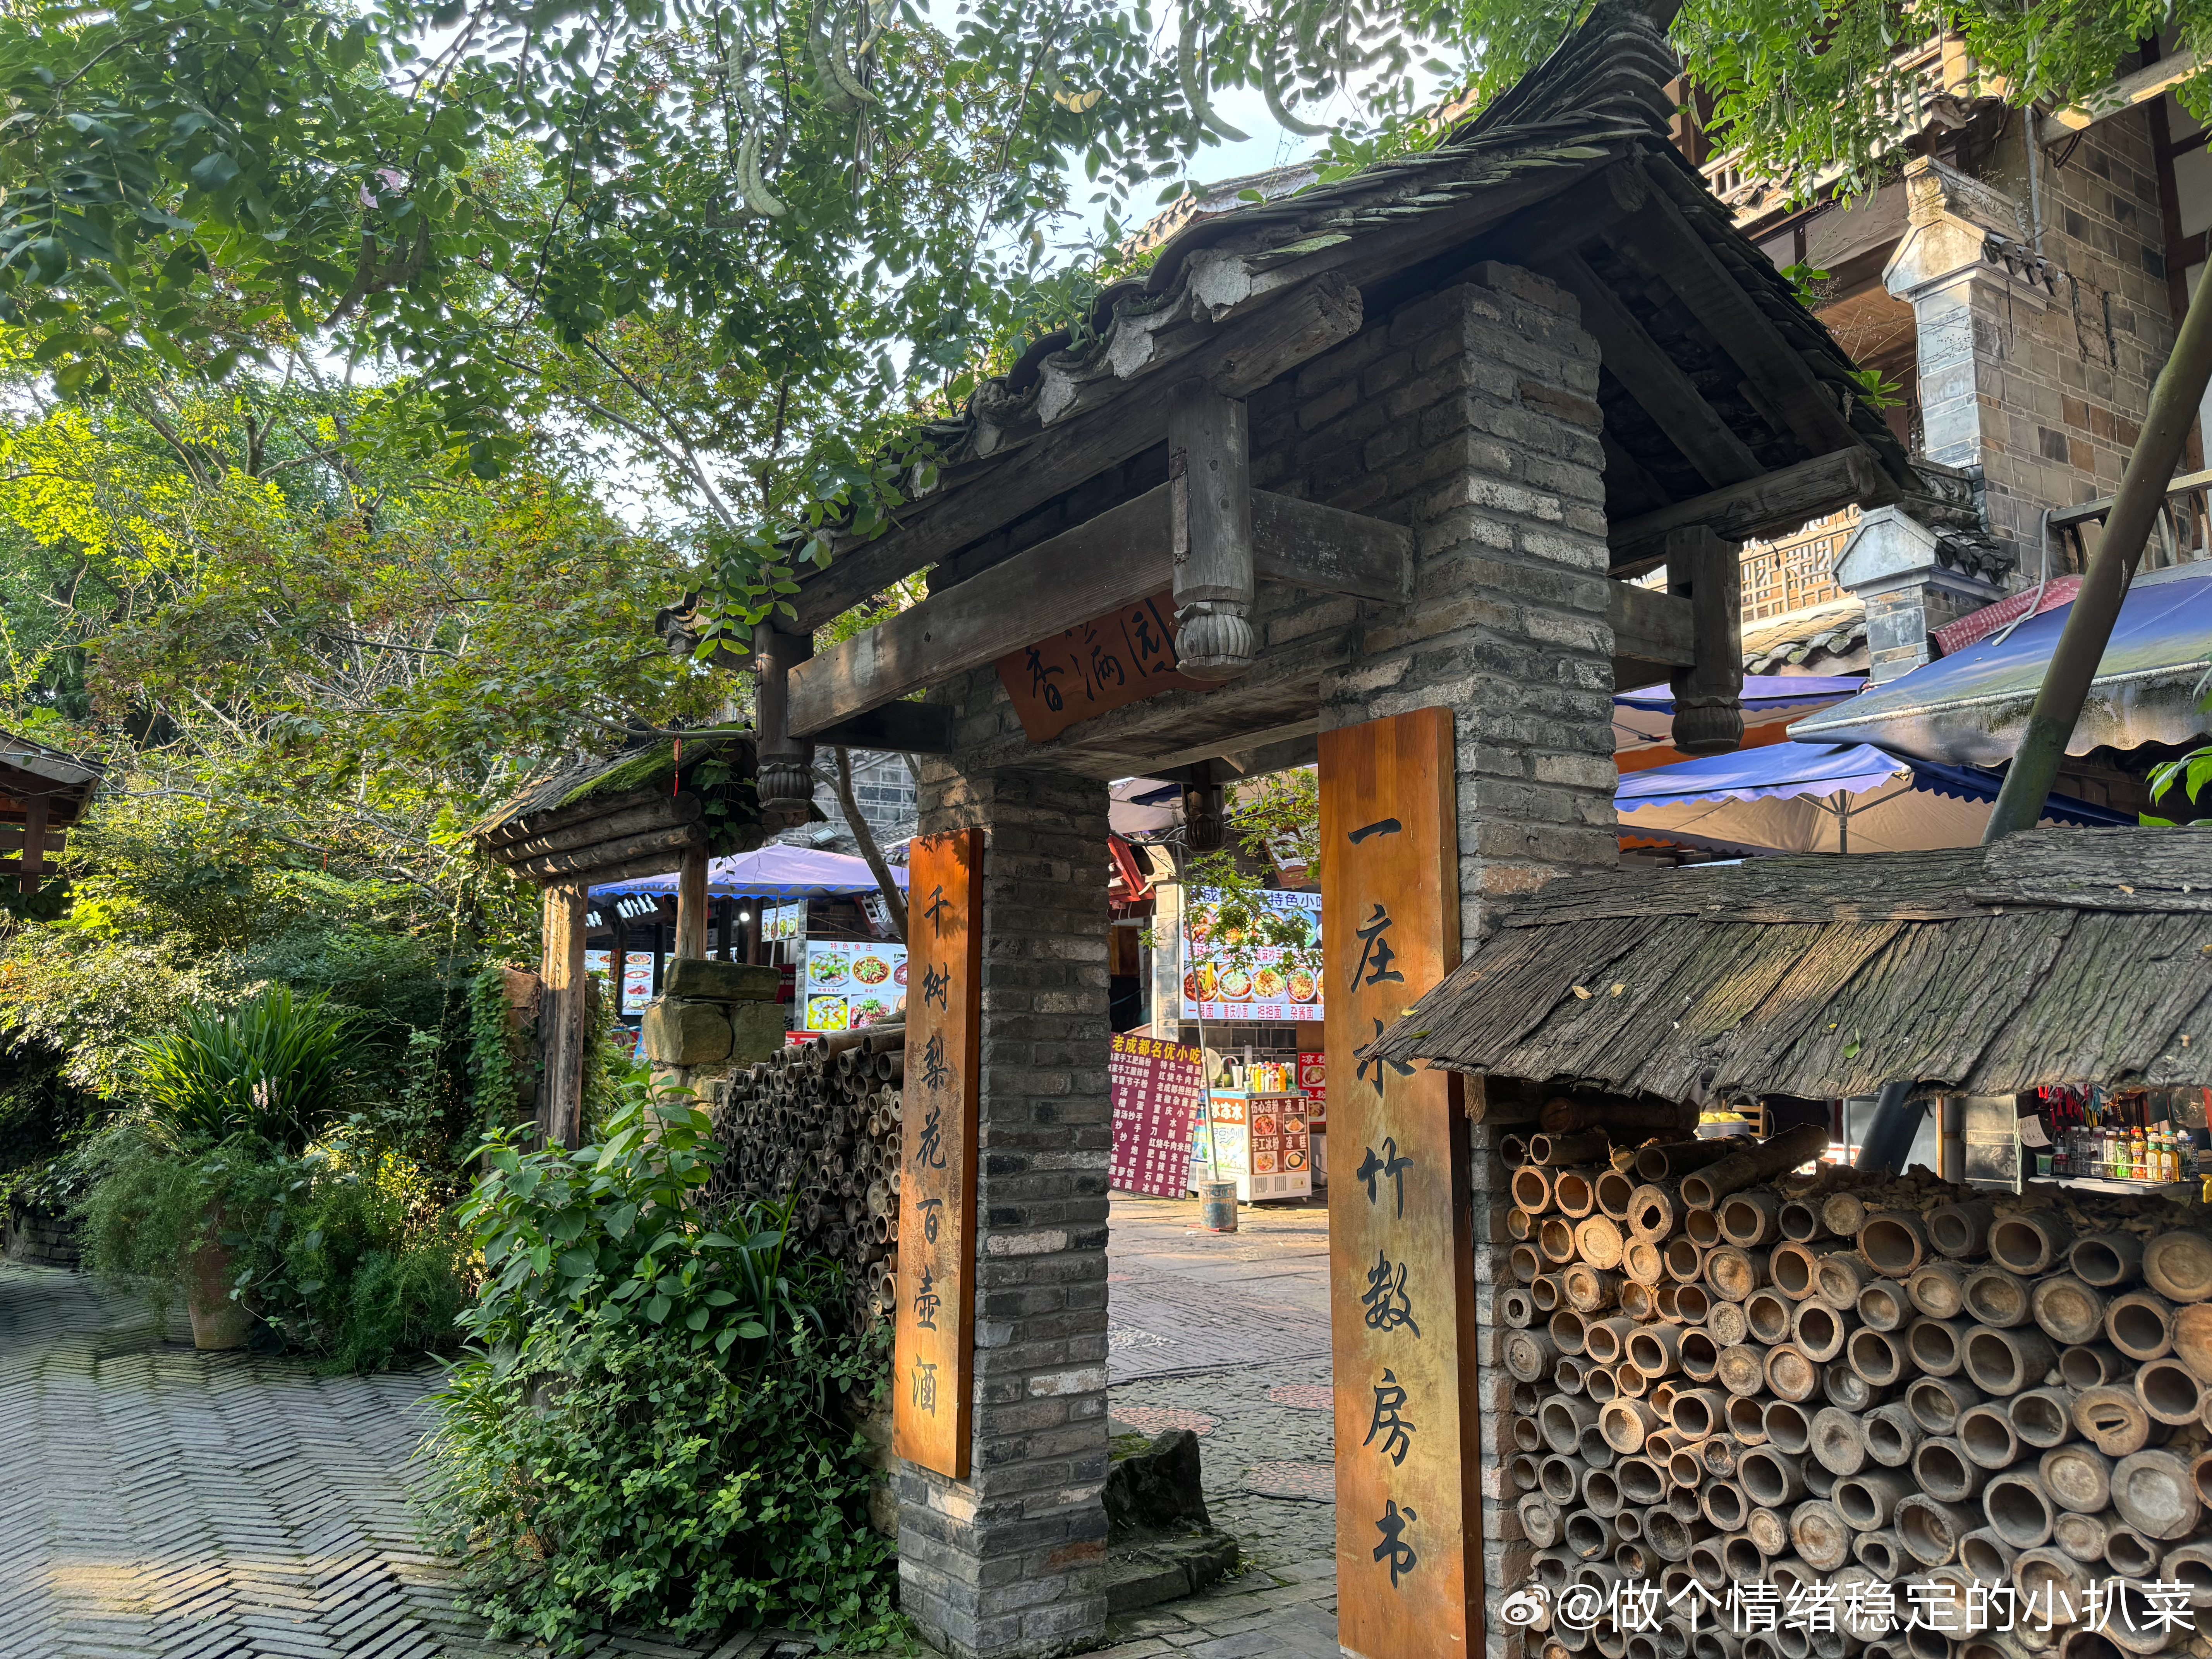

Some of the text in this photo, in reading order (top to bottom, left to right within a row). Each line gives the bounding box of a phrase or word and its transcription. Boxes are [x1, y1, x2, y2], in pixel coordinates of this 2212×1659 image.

[830, 943, 872, 951] 特色鱼庄
[1224, 1005, 1248, 1018] 重庆小面
[1258, 1006, 1281, 1019] 担担面
[1290, 1006, 1314, 1020] 杂酱面
[1112, 1034, 1201, 1064] 老成都名优小吃
[1160, 1060, 1202, 1075] 特色一根面
[1158, 1071, 1200, 1086] 红烧牛肉面
[1156, 1082, 1199, 1097] 老成都担担面
[1153, 1104, 1196, 1120] 重庆小面
[1251, 1099, 1305, 1114] 伤心凉粉 凉面
[1113, 1108, 1143, 1121] 清汤抄手
[1152, 1115, 1195, 1131] 甜水面
[1113, 1131, 1140, 1144] 抄手
[1150, 1127, 1193, 1142] 刀削面
[1148, 1137, 1191, 1153] 红烧牛肉米线
[1252, 1134, 1306, 1151] 手工冰粉 凉糕
[912, 884, 951, 1419] 千树梨花百壶酒
[1147, 1149, 1190, 1165] 肥肠米线
[1146, 1159, 1188, 1176] 香辣豆花
[1144, 1171, 1187, 1187] 石磨豆花
[1142, 1183, 1159, 1194] 冰粉
